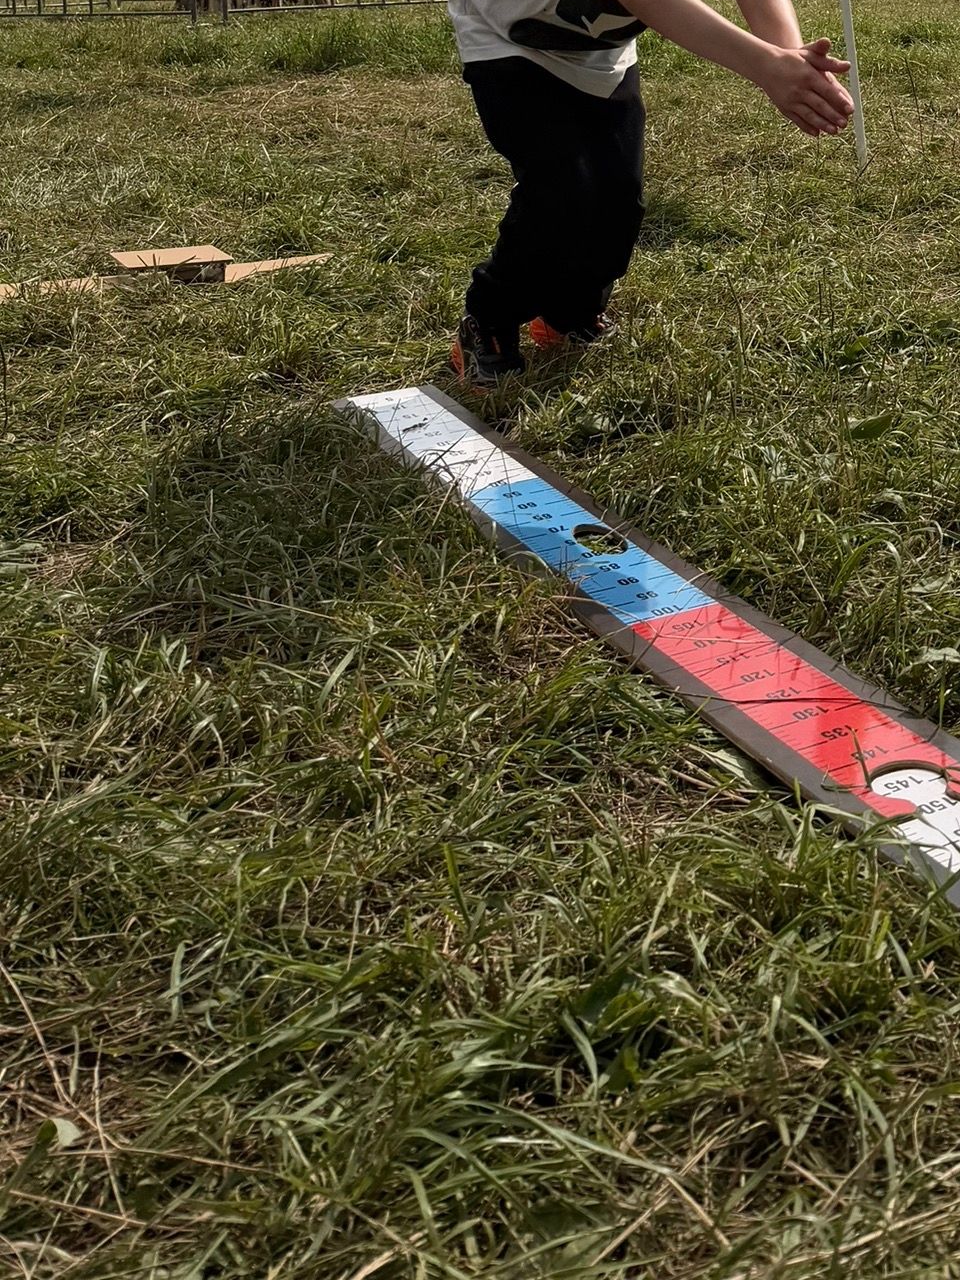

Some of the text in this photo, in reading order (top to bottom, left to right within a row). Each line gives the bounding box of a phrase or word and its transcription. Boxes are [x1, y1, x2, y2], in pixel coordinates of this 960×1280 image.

[502, 491, 522, 499] 55
[517, 501, 538, 510] 60
[532, 513, 553, 521] 65
[547, 525, 570, 534] 70
[599, 563, 621, 573] 85
[616, 577, 640, 586] 90
[636, 591, 659, 601] 95
[650, 604, 684, 617] 100
[671, 621, 704, 632] 105
[740, 669, 776, 683] 120
[766, 686, 801, 699] 125
[792, 706, 829, 720] 130
[820, 724, 858, 740] 135
[884, 775, 924, 793] 145
[916, 796, 959, 815] 150
